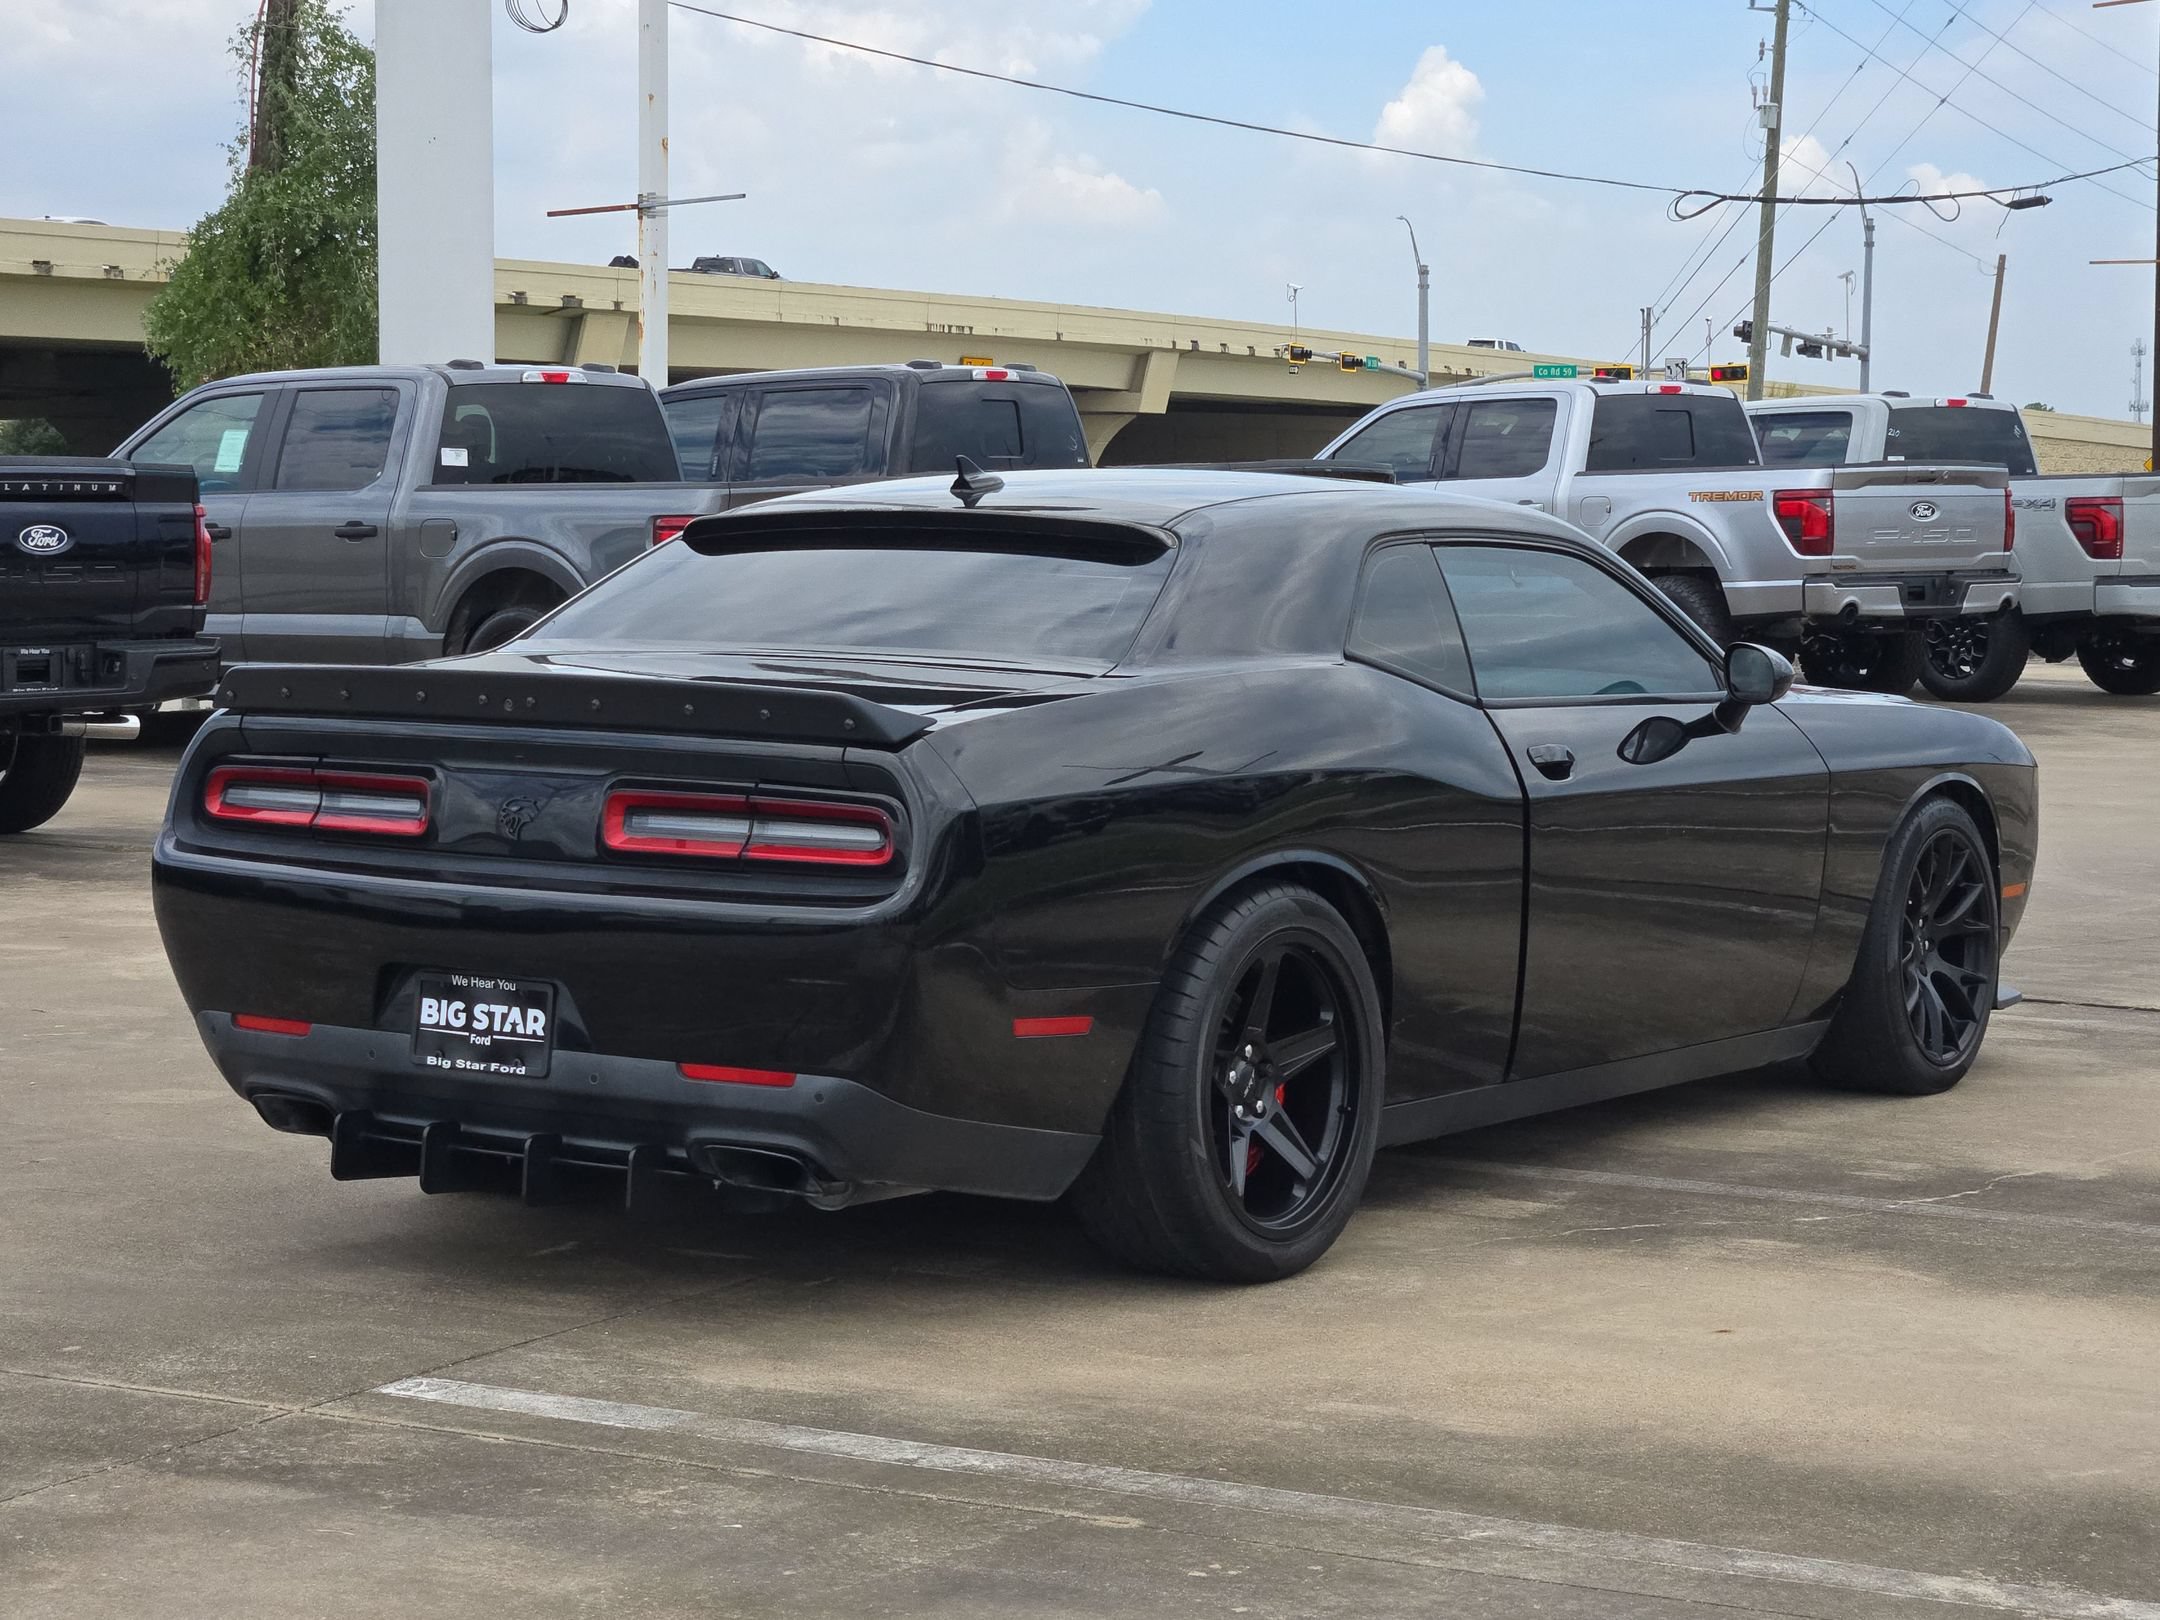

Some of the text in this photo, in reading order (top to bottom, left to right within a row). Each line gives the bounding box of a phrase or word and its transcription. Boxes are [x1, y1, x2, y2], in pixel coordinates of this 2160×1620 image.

[1538, 367, 1549, 376] Co
[4, 483, 117, 492] LATINUM
[1688, 490, 1764, 503] TREMOR
[451, 974, 517, 991] We Hear You
[420, 997, 546, 1036] BIG STAR
[470, 1034, 492, 1046] Ford
[426, 1056, 527, 1075] Big Star Ford
